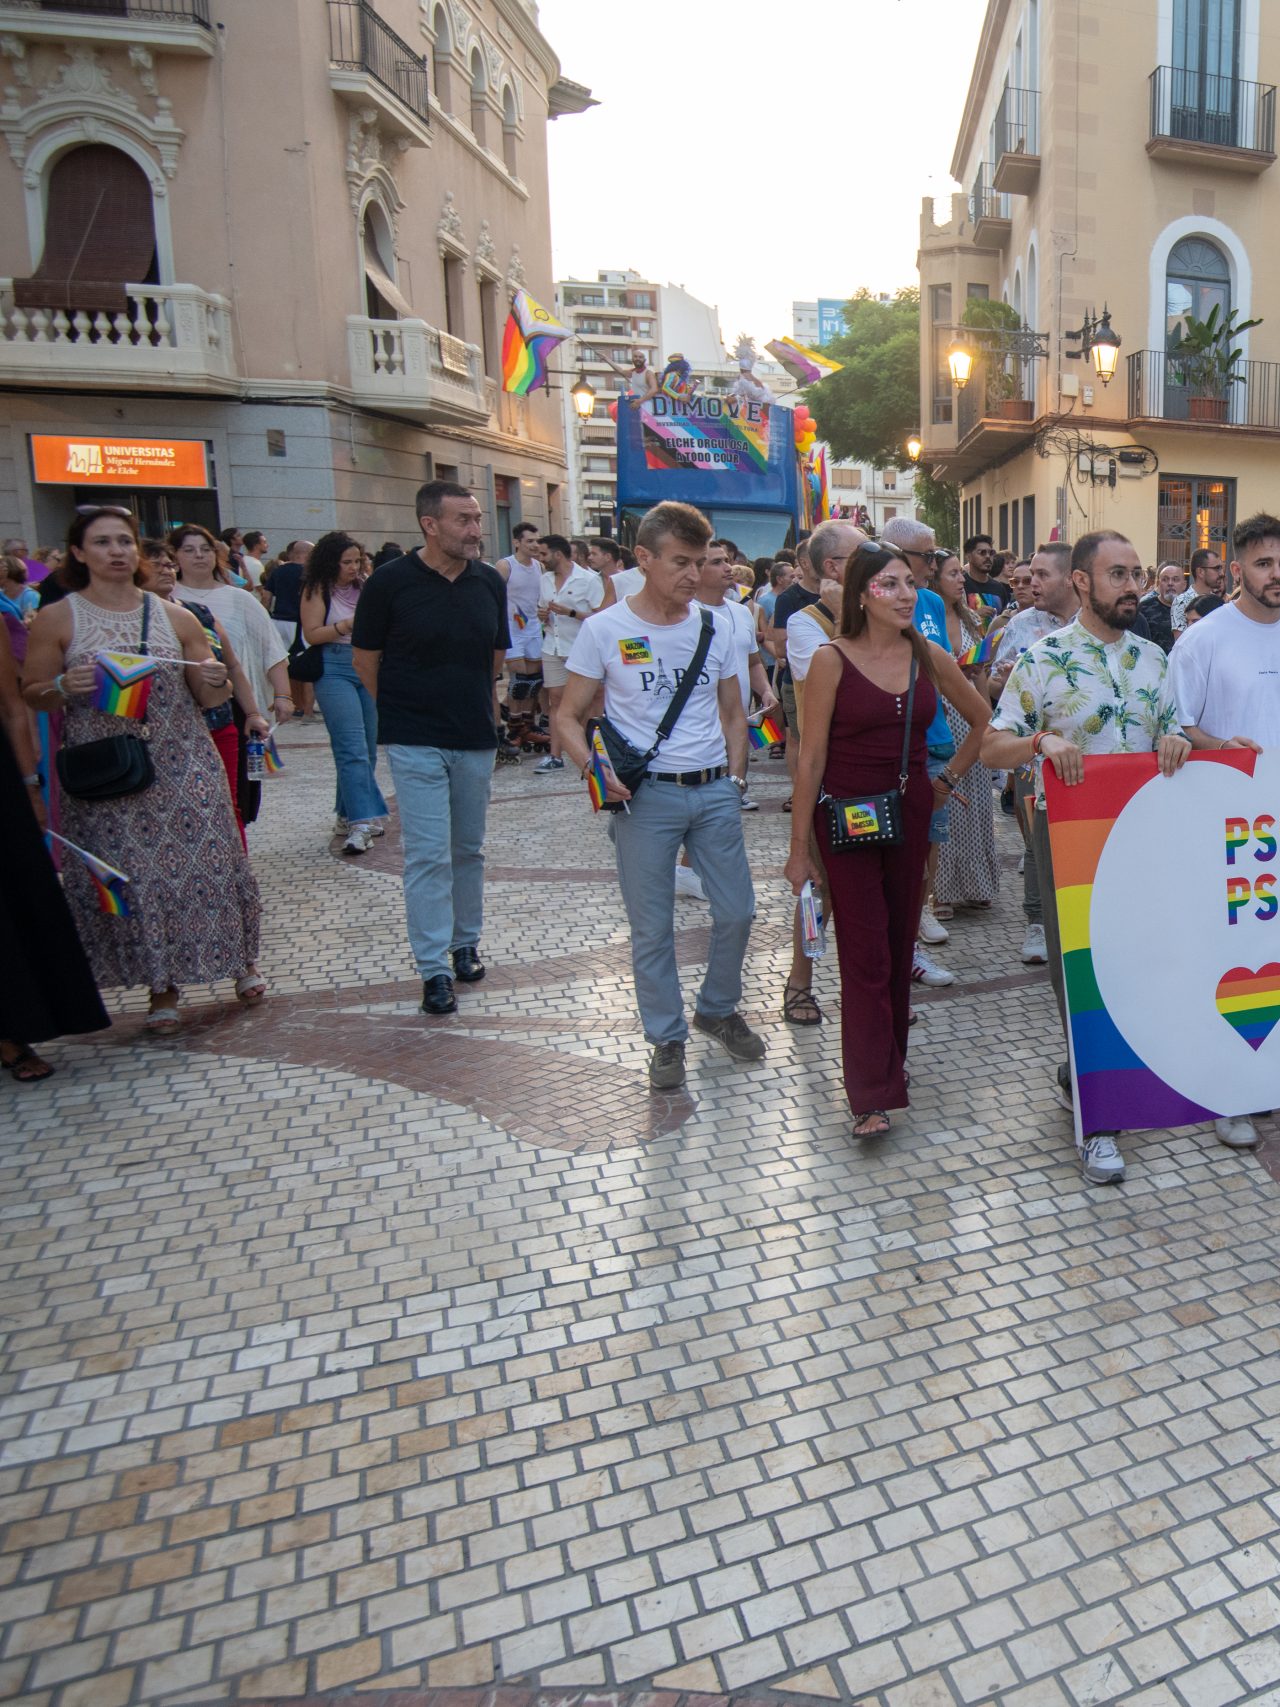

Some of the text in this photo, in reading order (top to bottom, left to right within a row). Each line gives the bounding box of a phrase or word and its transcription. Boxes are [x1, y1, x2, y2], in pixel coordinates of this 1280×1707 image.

[652, 396, 762, 423] DIMOVE
[666, 438, 695, 448] ELCHE
[104, 446, 175, 458] UNIVERSITAS
[684, 452, 711, 462] TODO
[107, 457, 176, 467] Miguel Hernández
[118, 467, 139, 475] Elche
